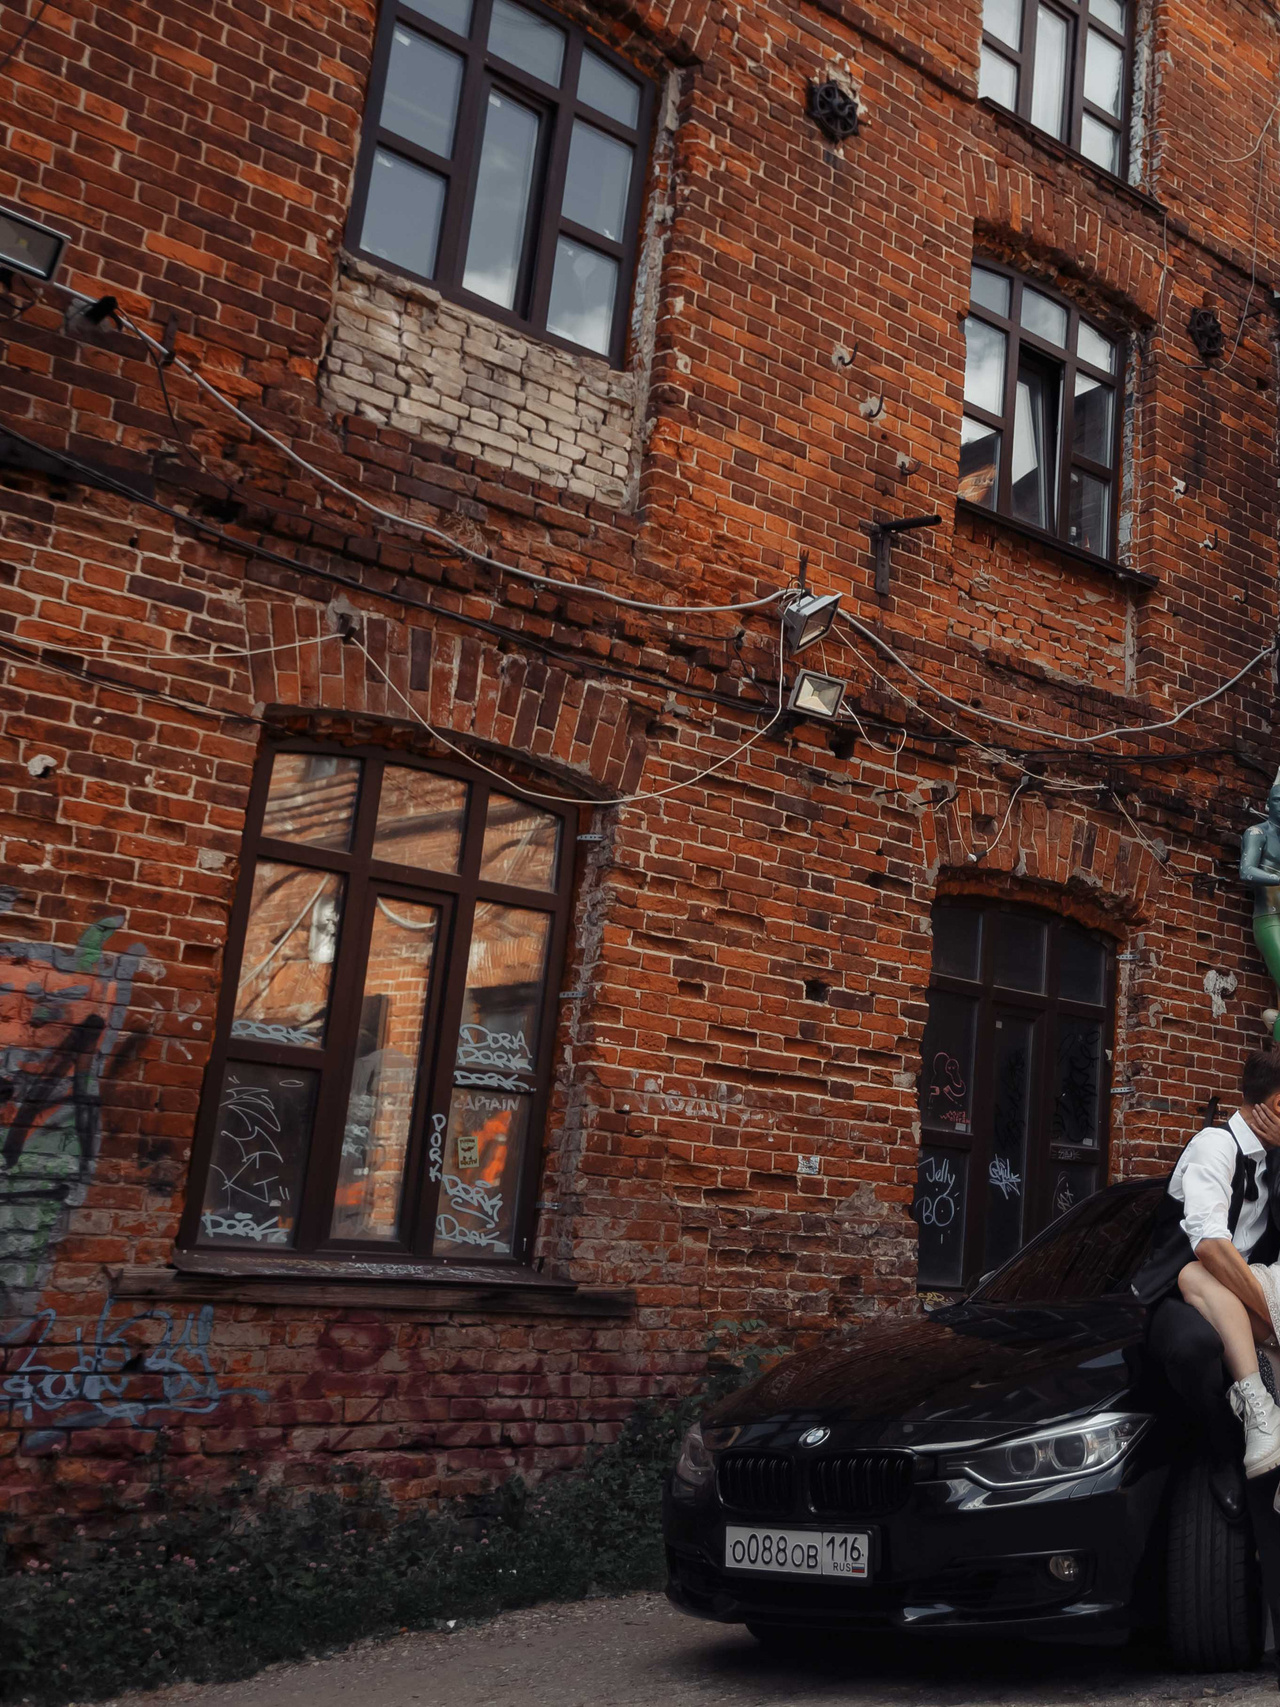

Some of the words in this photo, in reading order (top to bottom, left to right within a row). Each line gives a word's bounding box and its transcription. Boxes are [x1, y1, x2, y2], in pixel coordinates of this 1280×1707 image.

[429, 1113, 447, 1182] DORK
[919, 1157, 955, 1197] Jelly
[826, 1536, 861, 1562] 116
[833, 1562, 851, 1572] RUS
